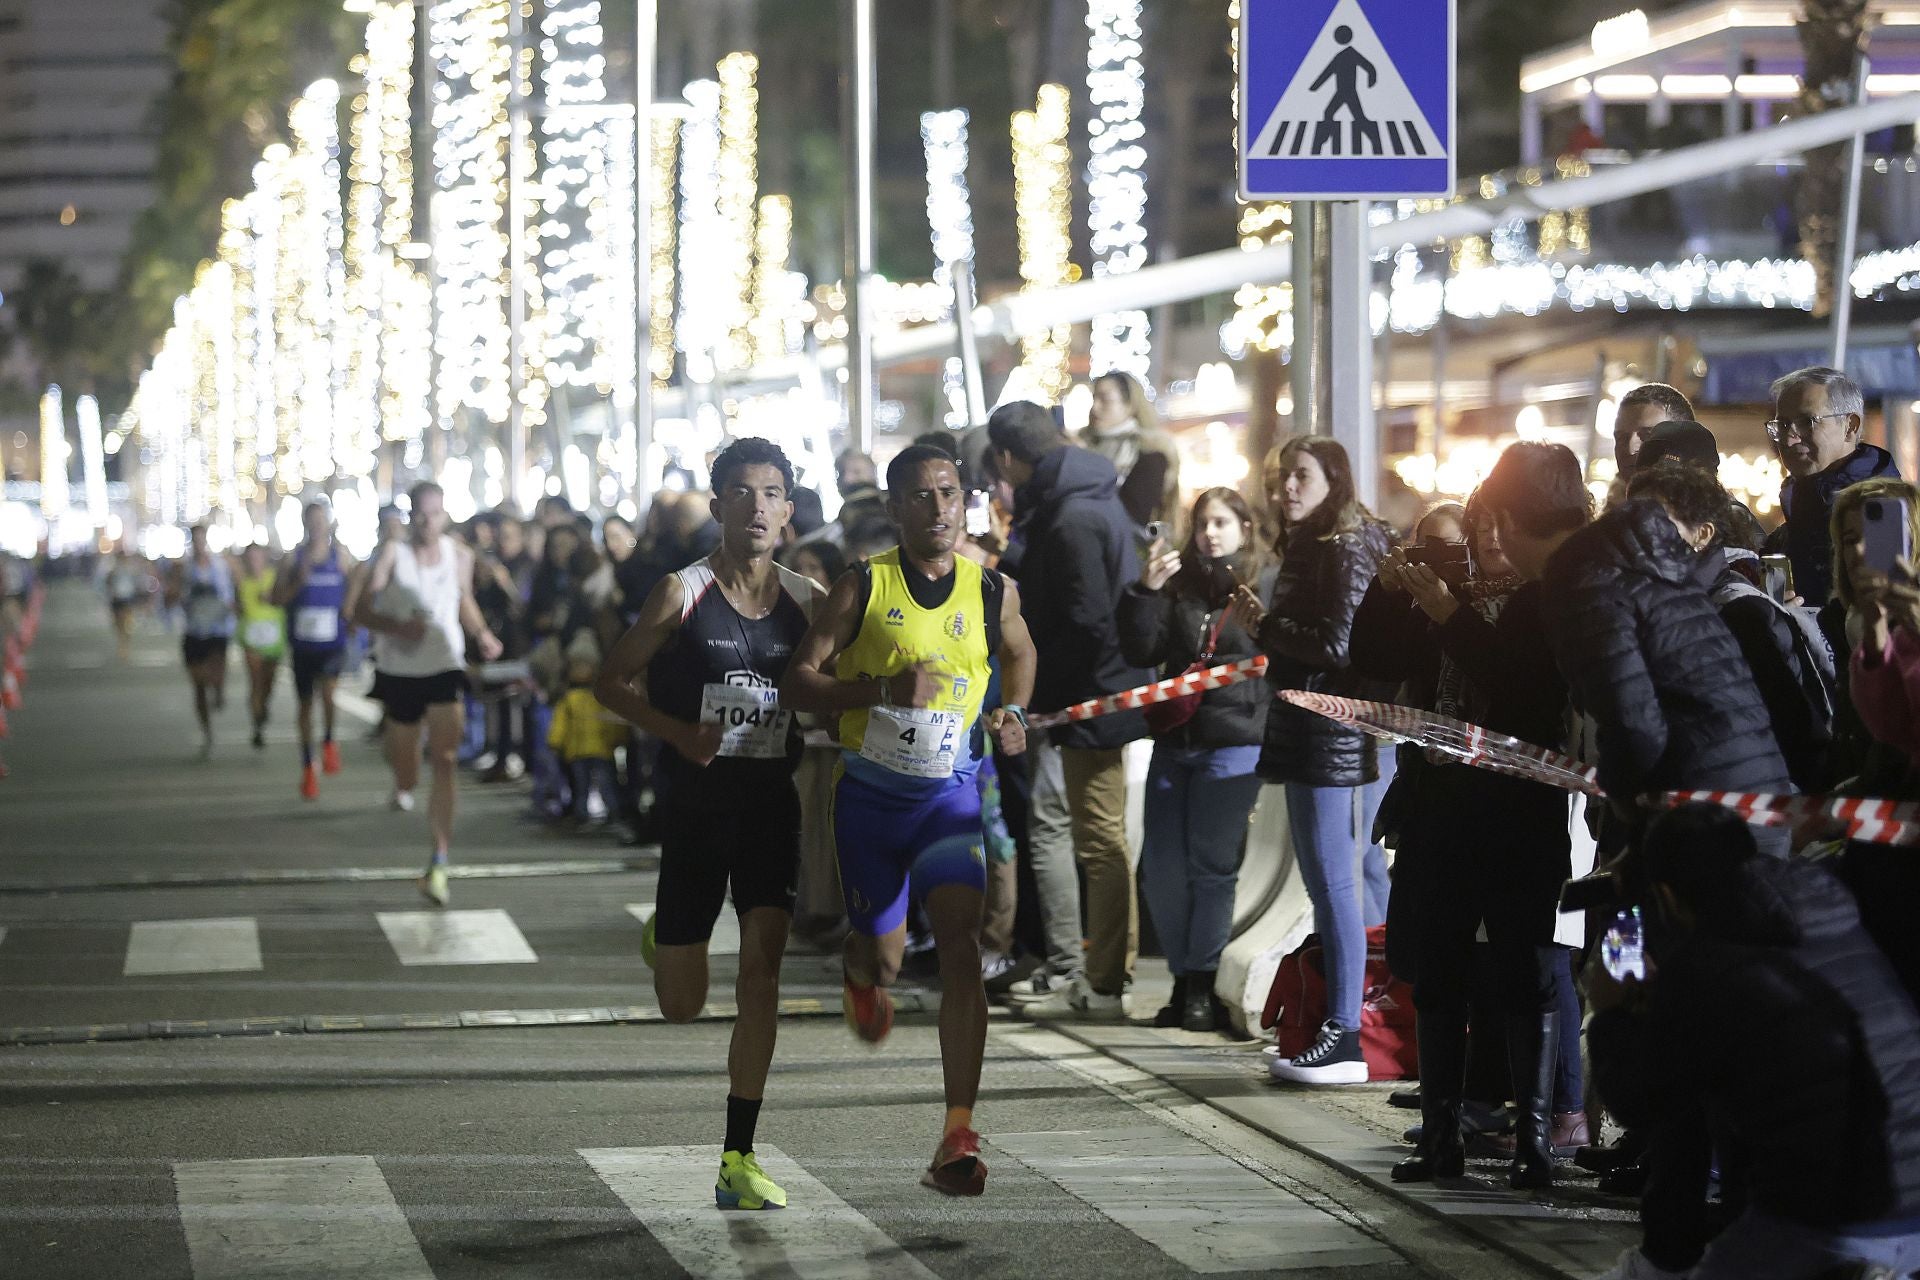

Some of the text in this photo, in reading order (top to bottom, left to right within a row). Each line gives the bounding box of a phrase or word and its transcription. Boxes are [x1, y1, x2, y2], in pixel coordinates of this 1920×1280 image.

[763, 691, 776, 703] M
[715, 706, 777, 728] 1047
[930, 713, 944, 724] M
[899, 727, 917, 746] 4
